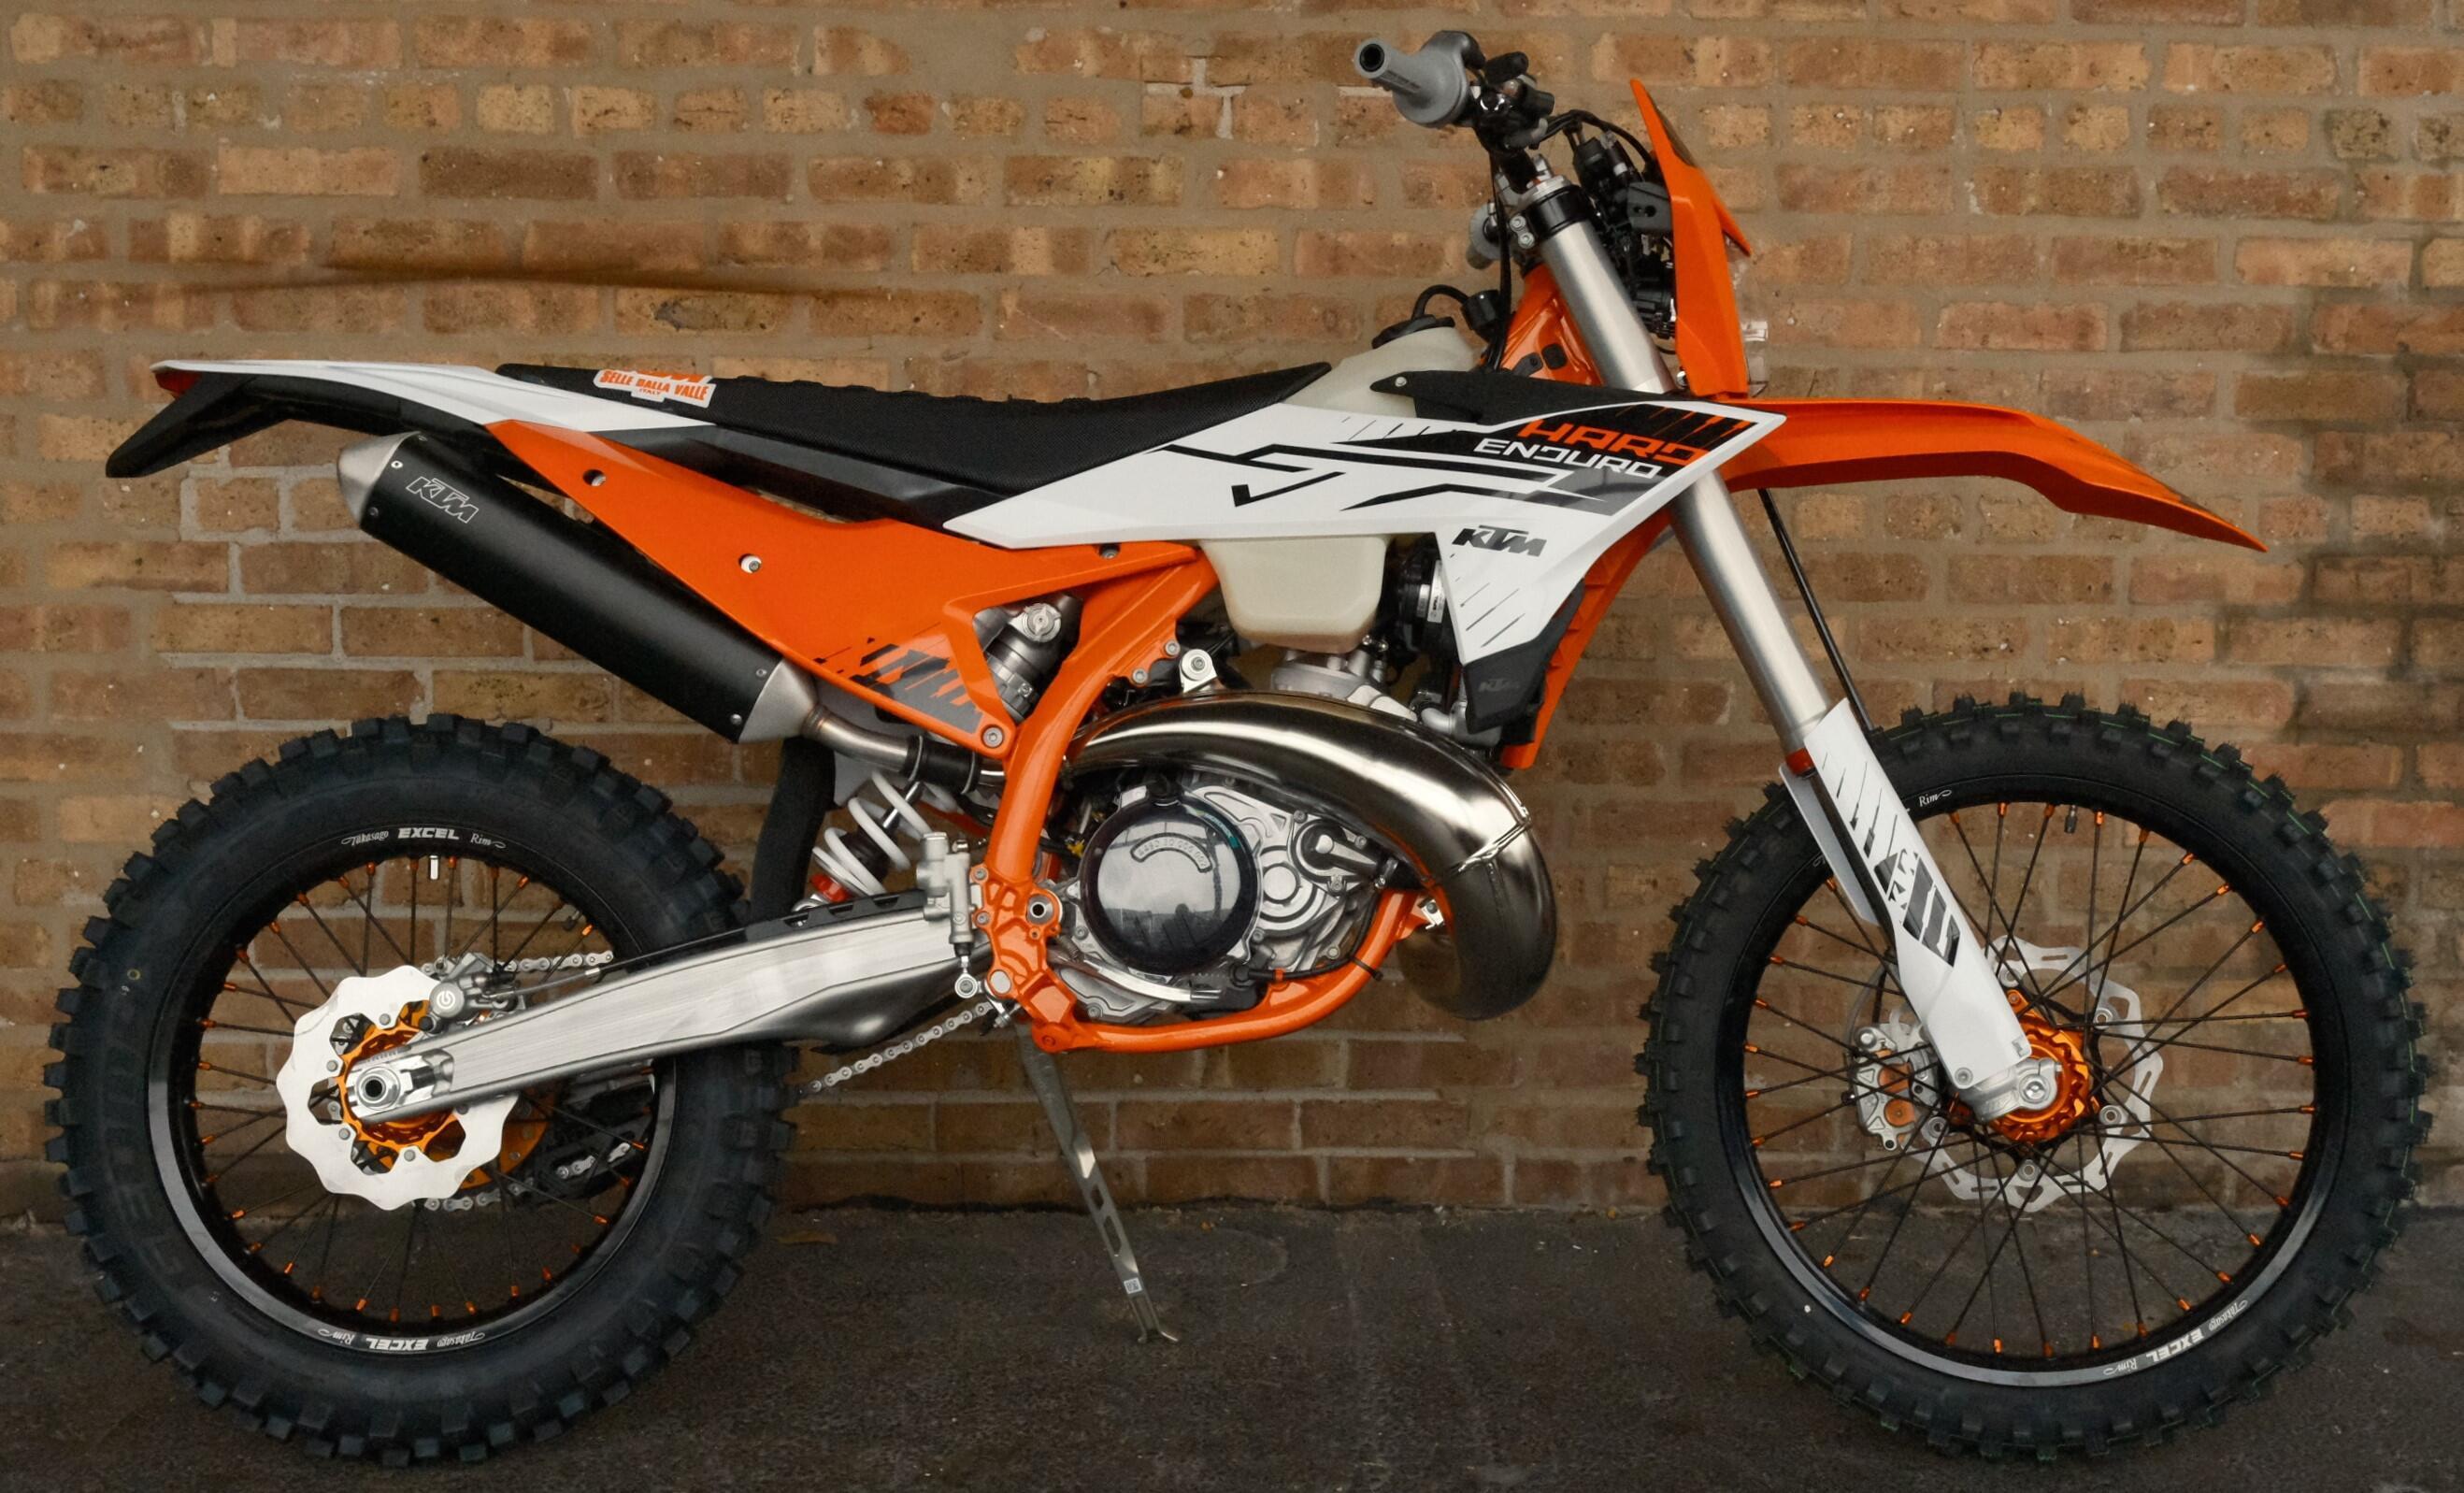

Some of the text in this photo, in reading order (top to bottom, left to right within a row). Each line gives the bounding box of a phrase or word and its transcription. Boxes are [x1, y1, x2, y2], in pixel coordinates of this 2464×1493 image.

[599, 370, 709, 401] SELLE DALLA VALLE
[1473, 438, 1663, 479] ENDURO
[1517, 419, 1712, 467] HARD
[406, 476, 480, 524] KTM
[1452, 524, 1547, 557] KTM
[1918, 789, 1953, 808] Rim
[397, 827, 460, 840] EXCEL
[470, 832, 507, 849] Rim
[365, 1337, 429, 1351] EXCEL
[2146, 1328, 2204, 1363] EXCEL
